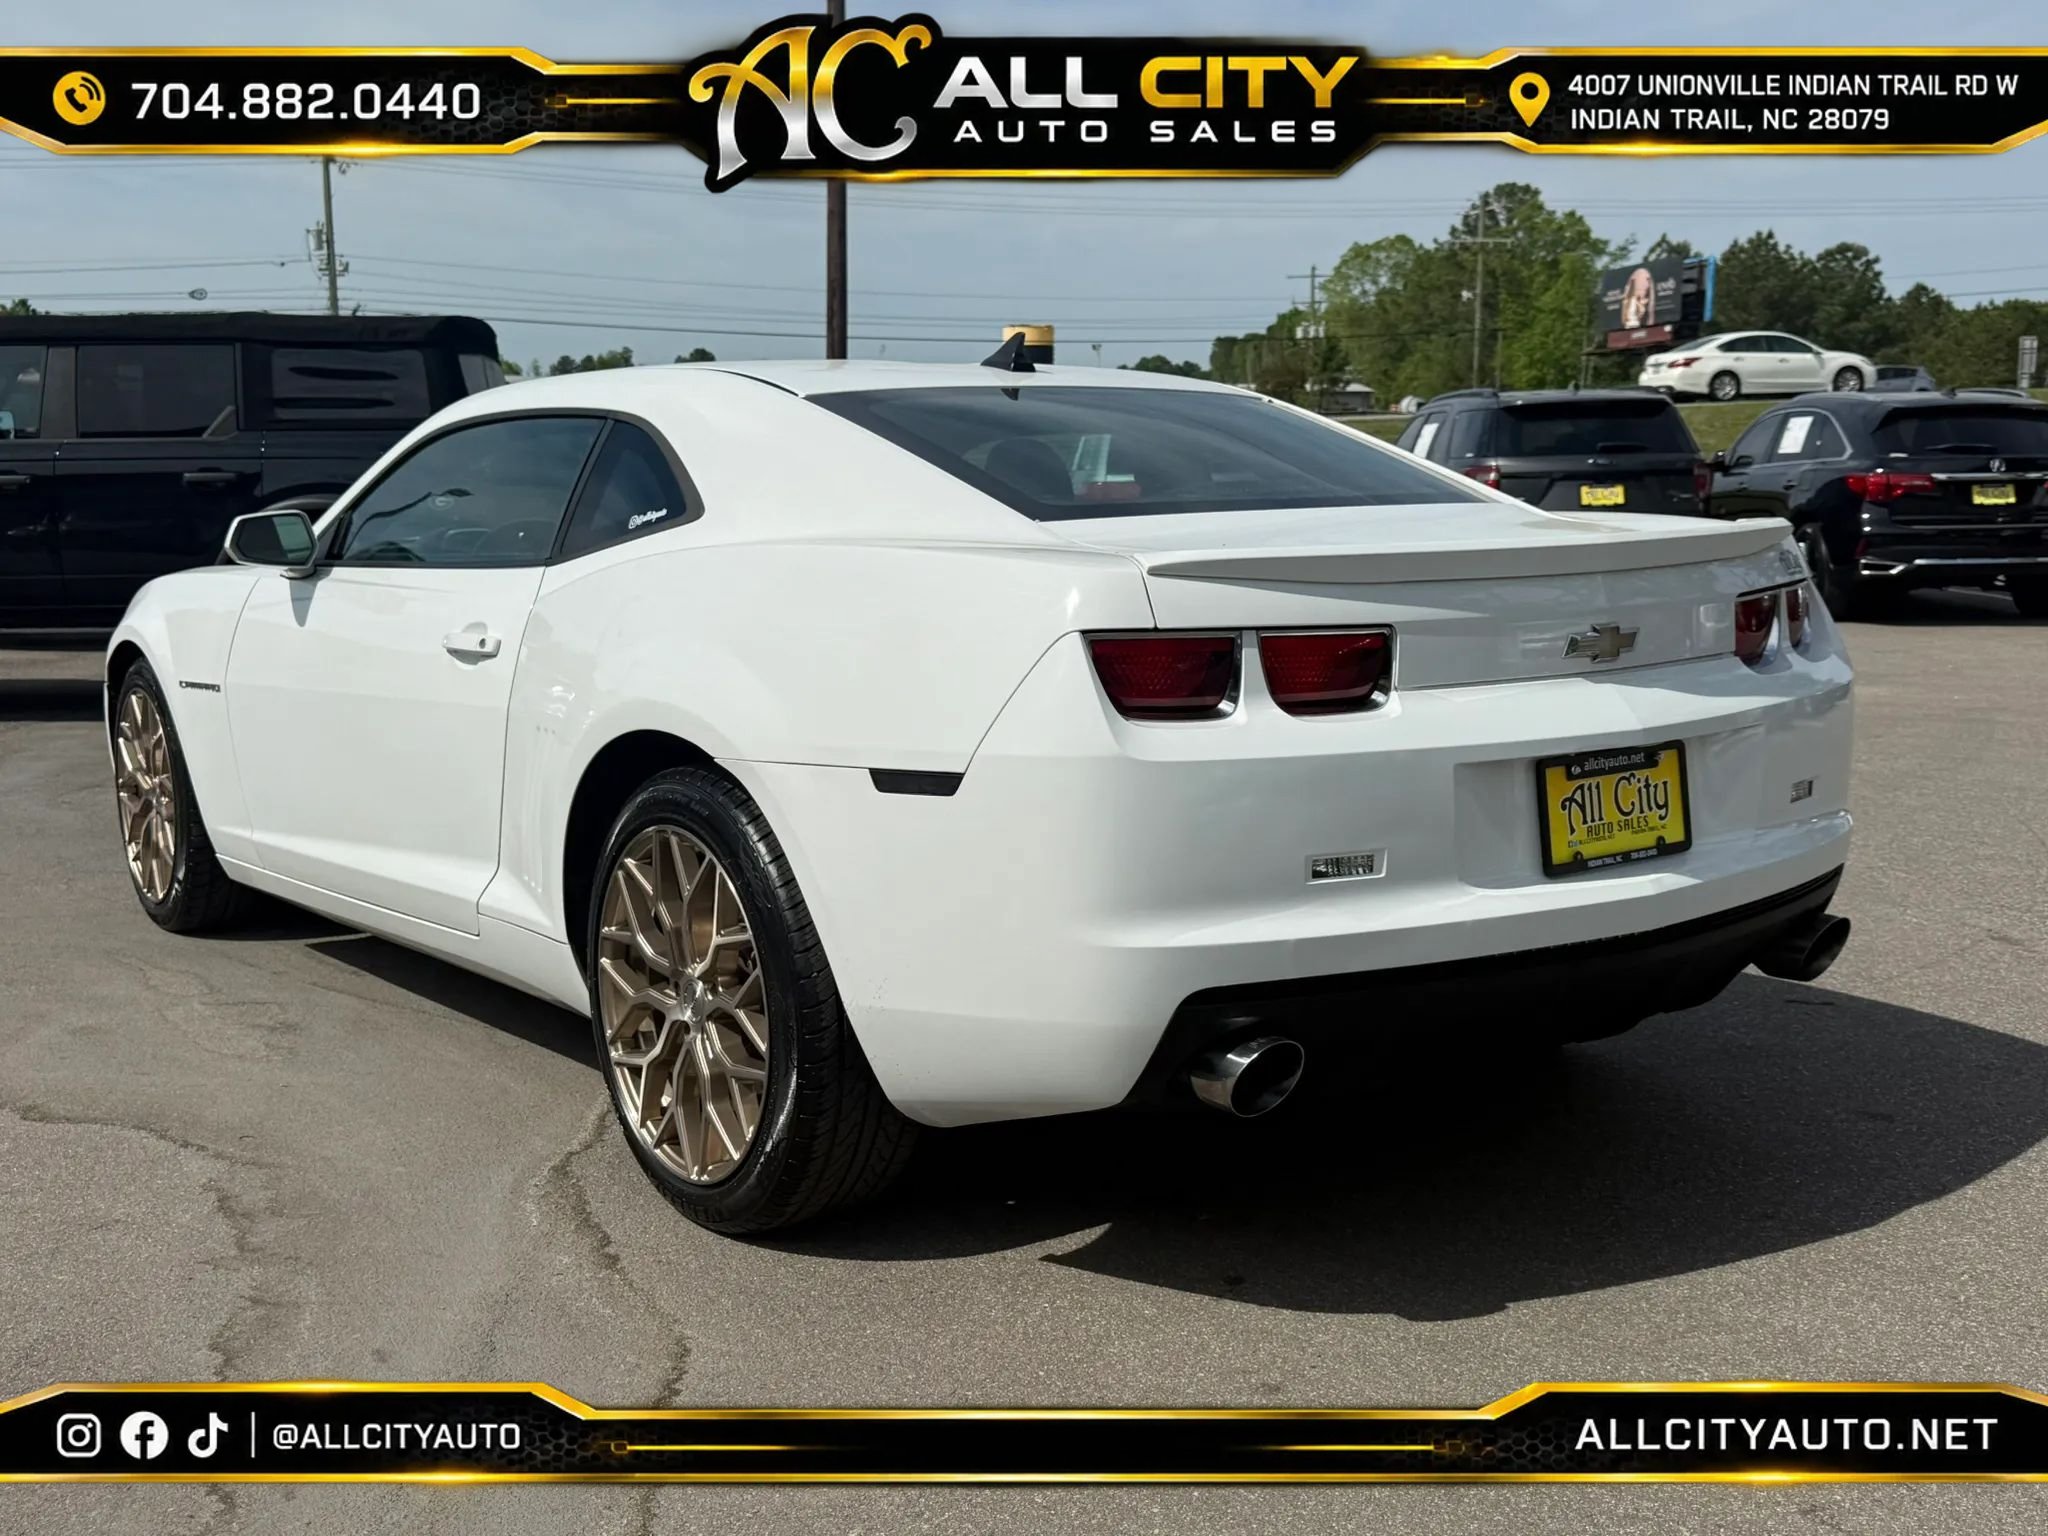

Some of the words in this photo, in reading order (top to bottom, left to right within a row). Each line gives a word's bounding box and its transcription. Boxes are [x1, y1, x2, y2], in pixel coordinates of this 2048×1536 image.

[1583, 752, 1646, 771] allcityauto.net
[1560, 780, 1604, 836] All
[1613, 771, 1670, 822] City
[1586, 821, 1614, 838] AUTO
[1617, 815, 1649, 833] SALES
